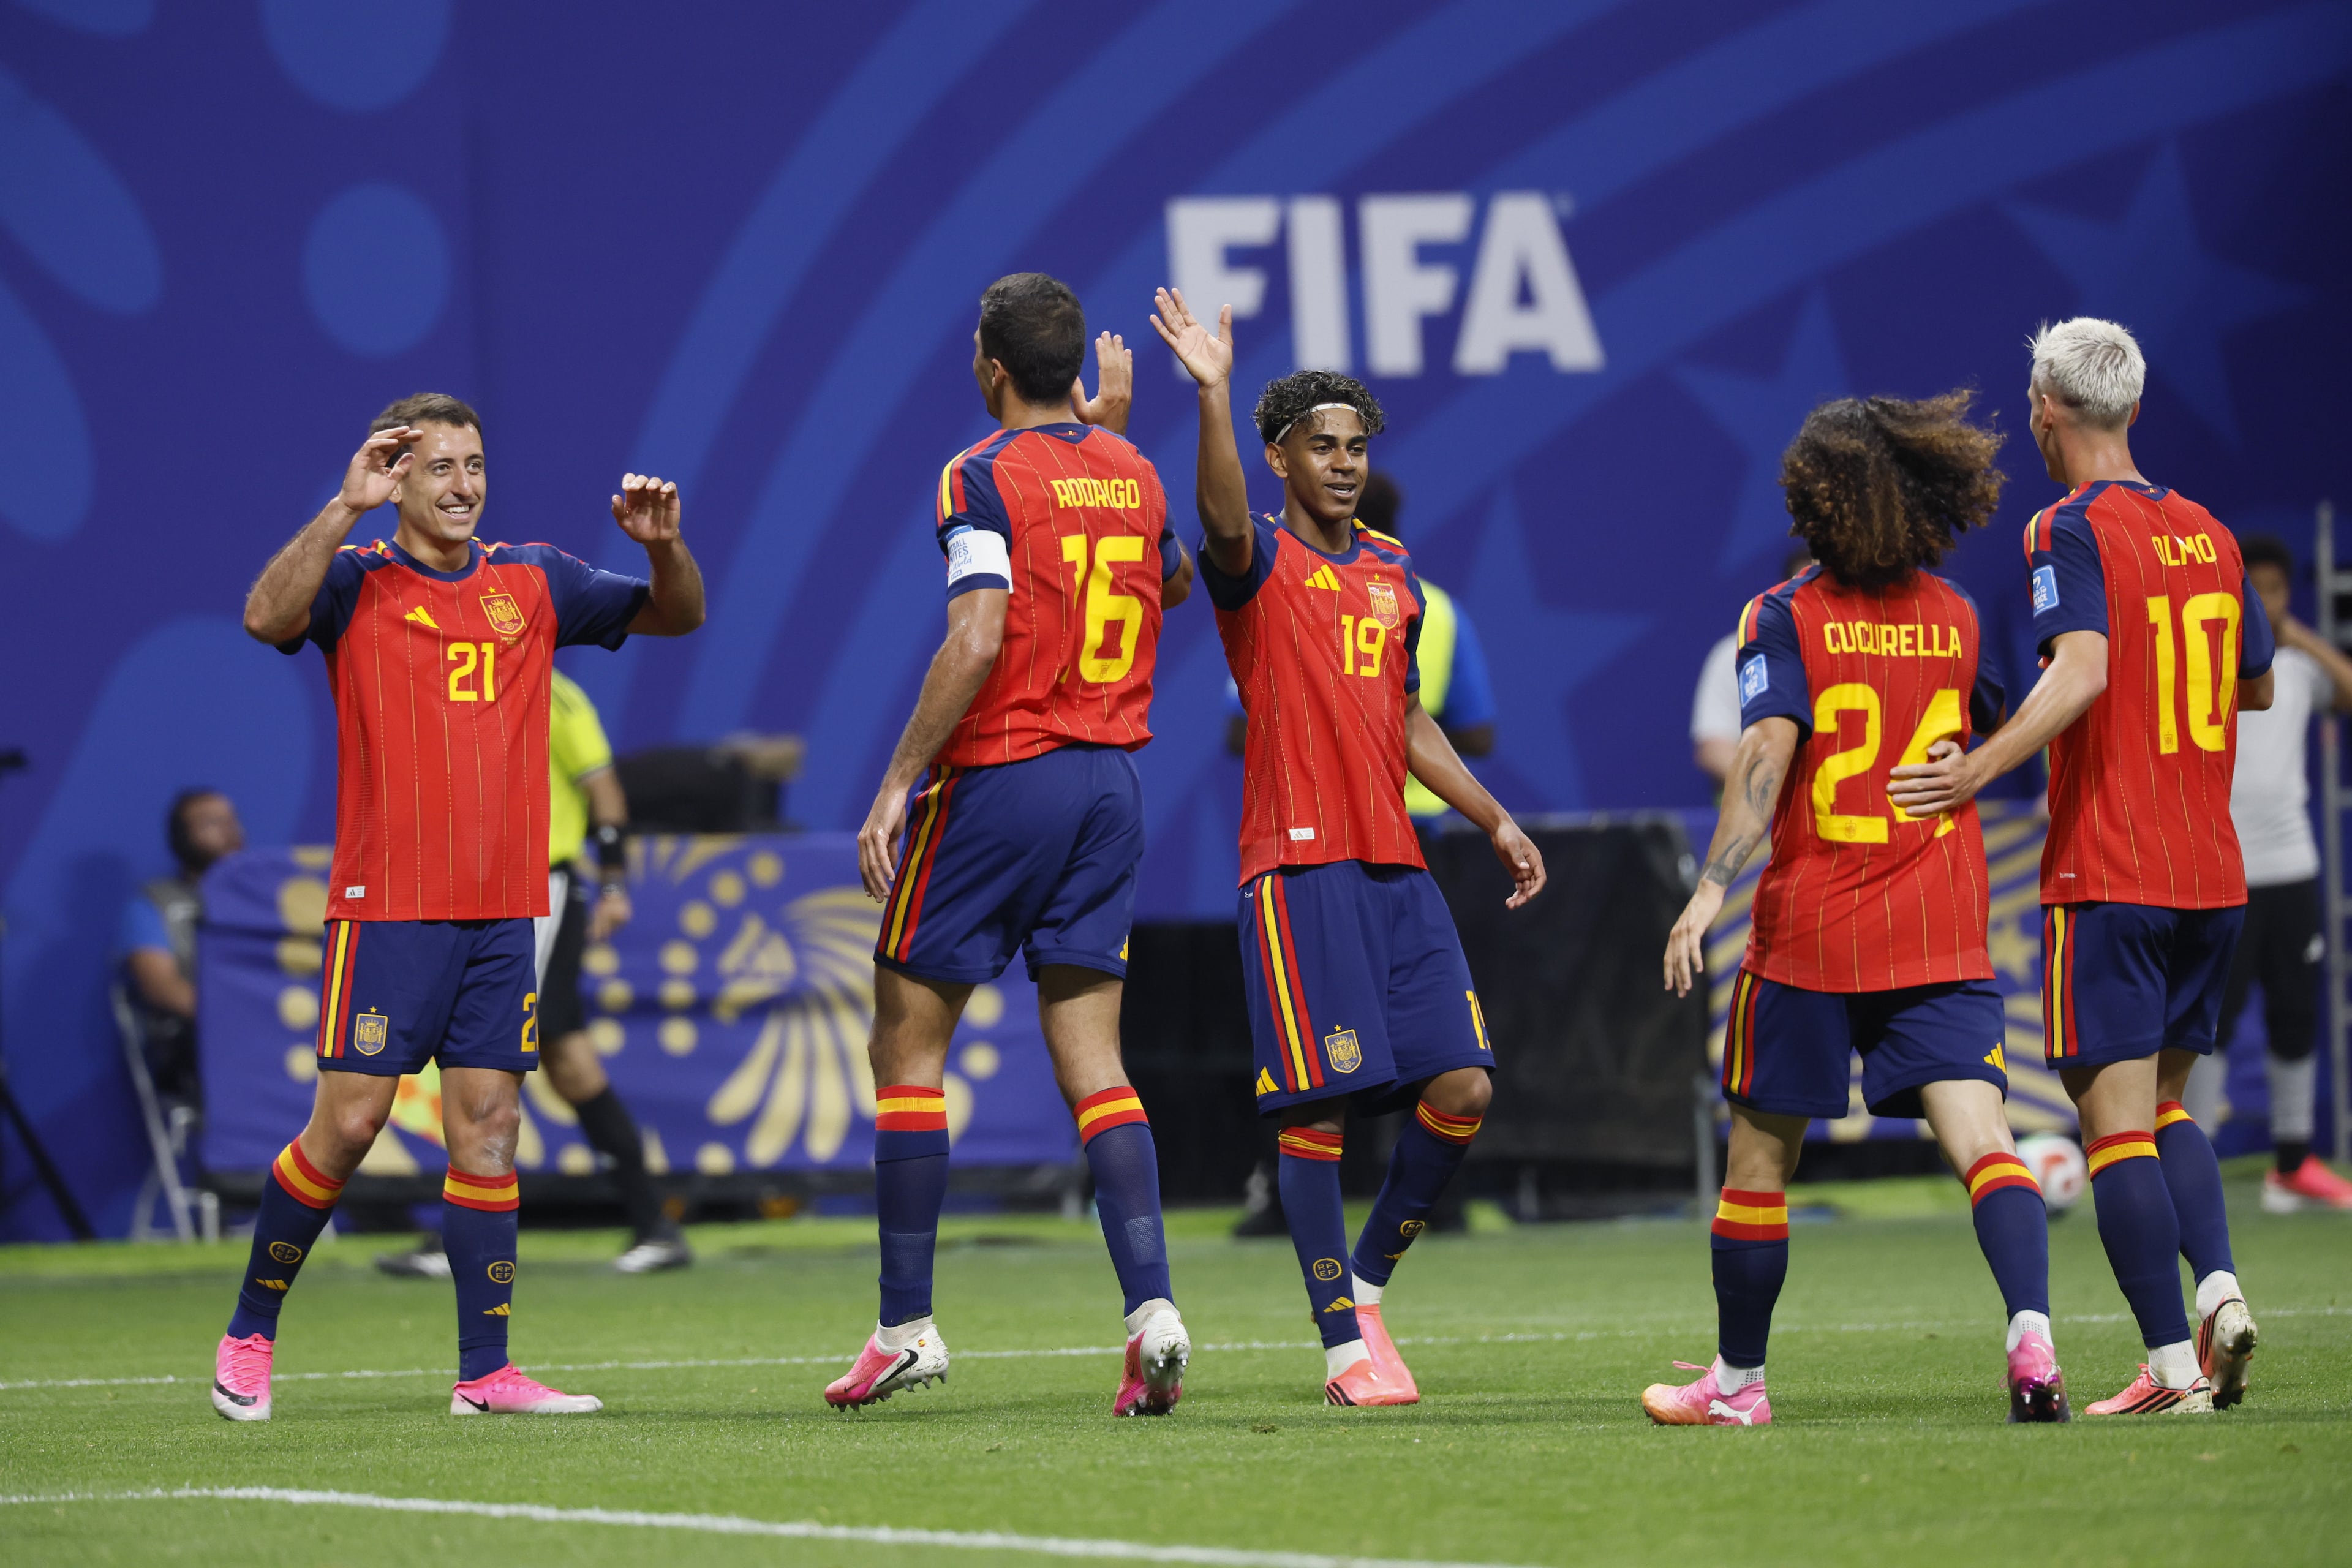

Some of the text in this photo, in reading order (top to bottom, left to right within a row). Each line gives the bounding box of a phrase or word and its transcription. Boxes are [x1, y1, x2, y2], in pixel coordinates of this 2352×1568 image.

[1165, 192, 1606, 380] FIFA
[1050, 478, 1140, 509] RODRIGO
[2151, 533, 2217, 567] OLMO
[1060, 533, 1144, 683] 16
[1823, 620, 1962, 659] CUCURELLA
[447, 641, 496, 701] 21
[1340, 614, 1386, 678] 19
[2146, 592, 2241, 755] 10
[1812, 682, 1962, 845] 24
